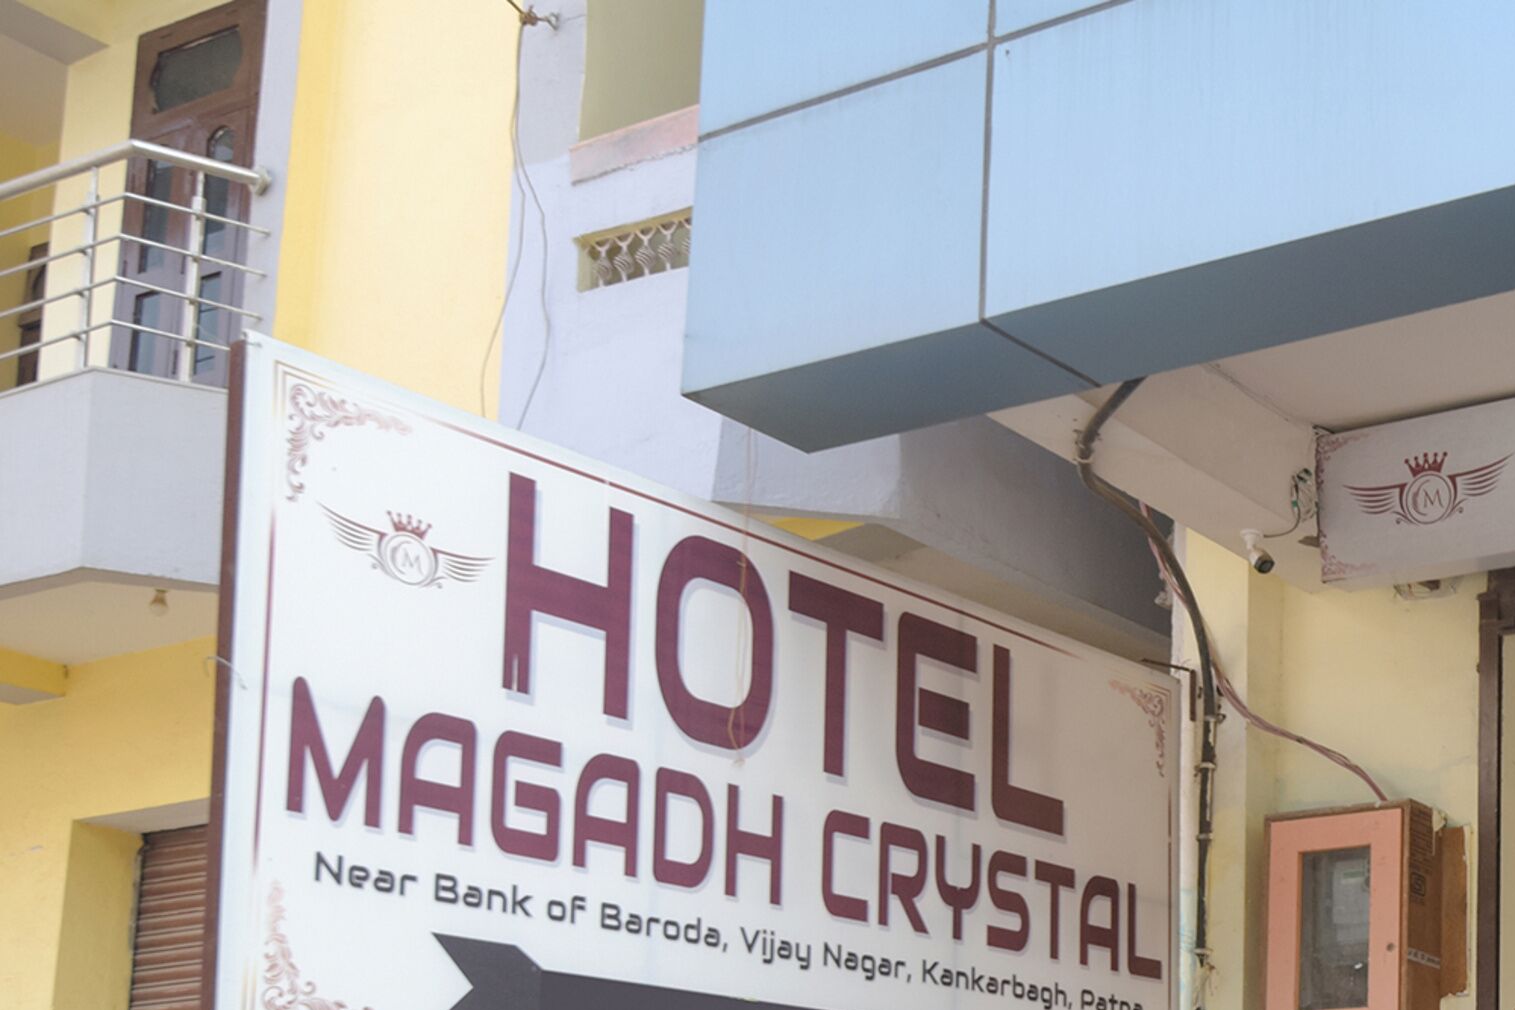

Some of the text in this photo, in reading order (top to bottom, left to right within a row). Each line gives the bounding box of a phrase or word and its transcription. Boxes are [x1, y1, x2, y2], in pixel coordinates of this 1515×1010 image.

[501, 471, 1066, 838] HOTEL
[285, 675, 1164, 982] MAGADH CRYSTAL
[313, 850, 419, 897] Near
[434, 872, 534, 918] Bank
[546, 895, 588, 925] of
[600, 902, 730, 953] Baroda,
[740, 926, 813, 971] Vijay
[823, 941, 913, 985] Nagar,
